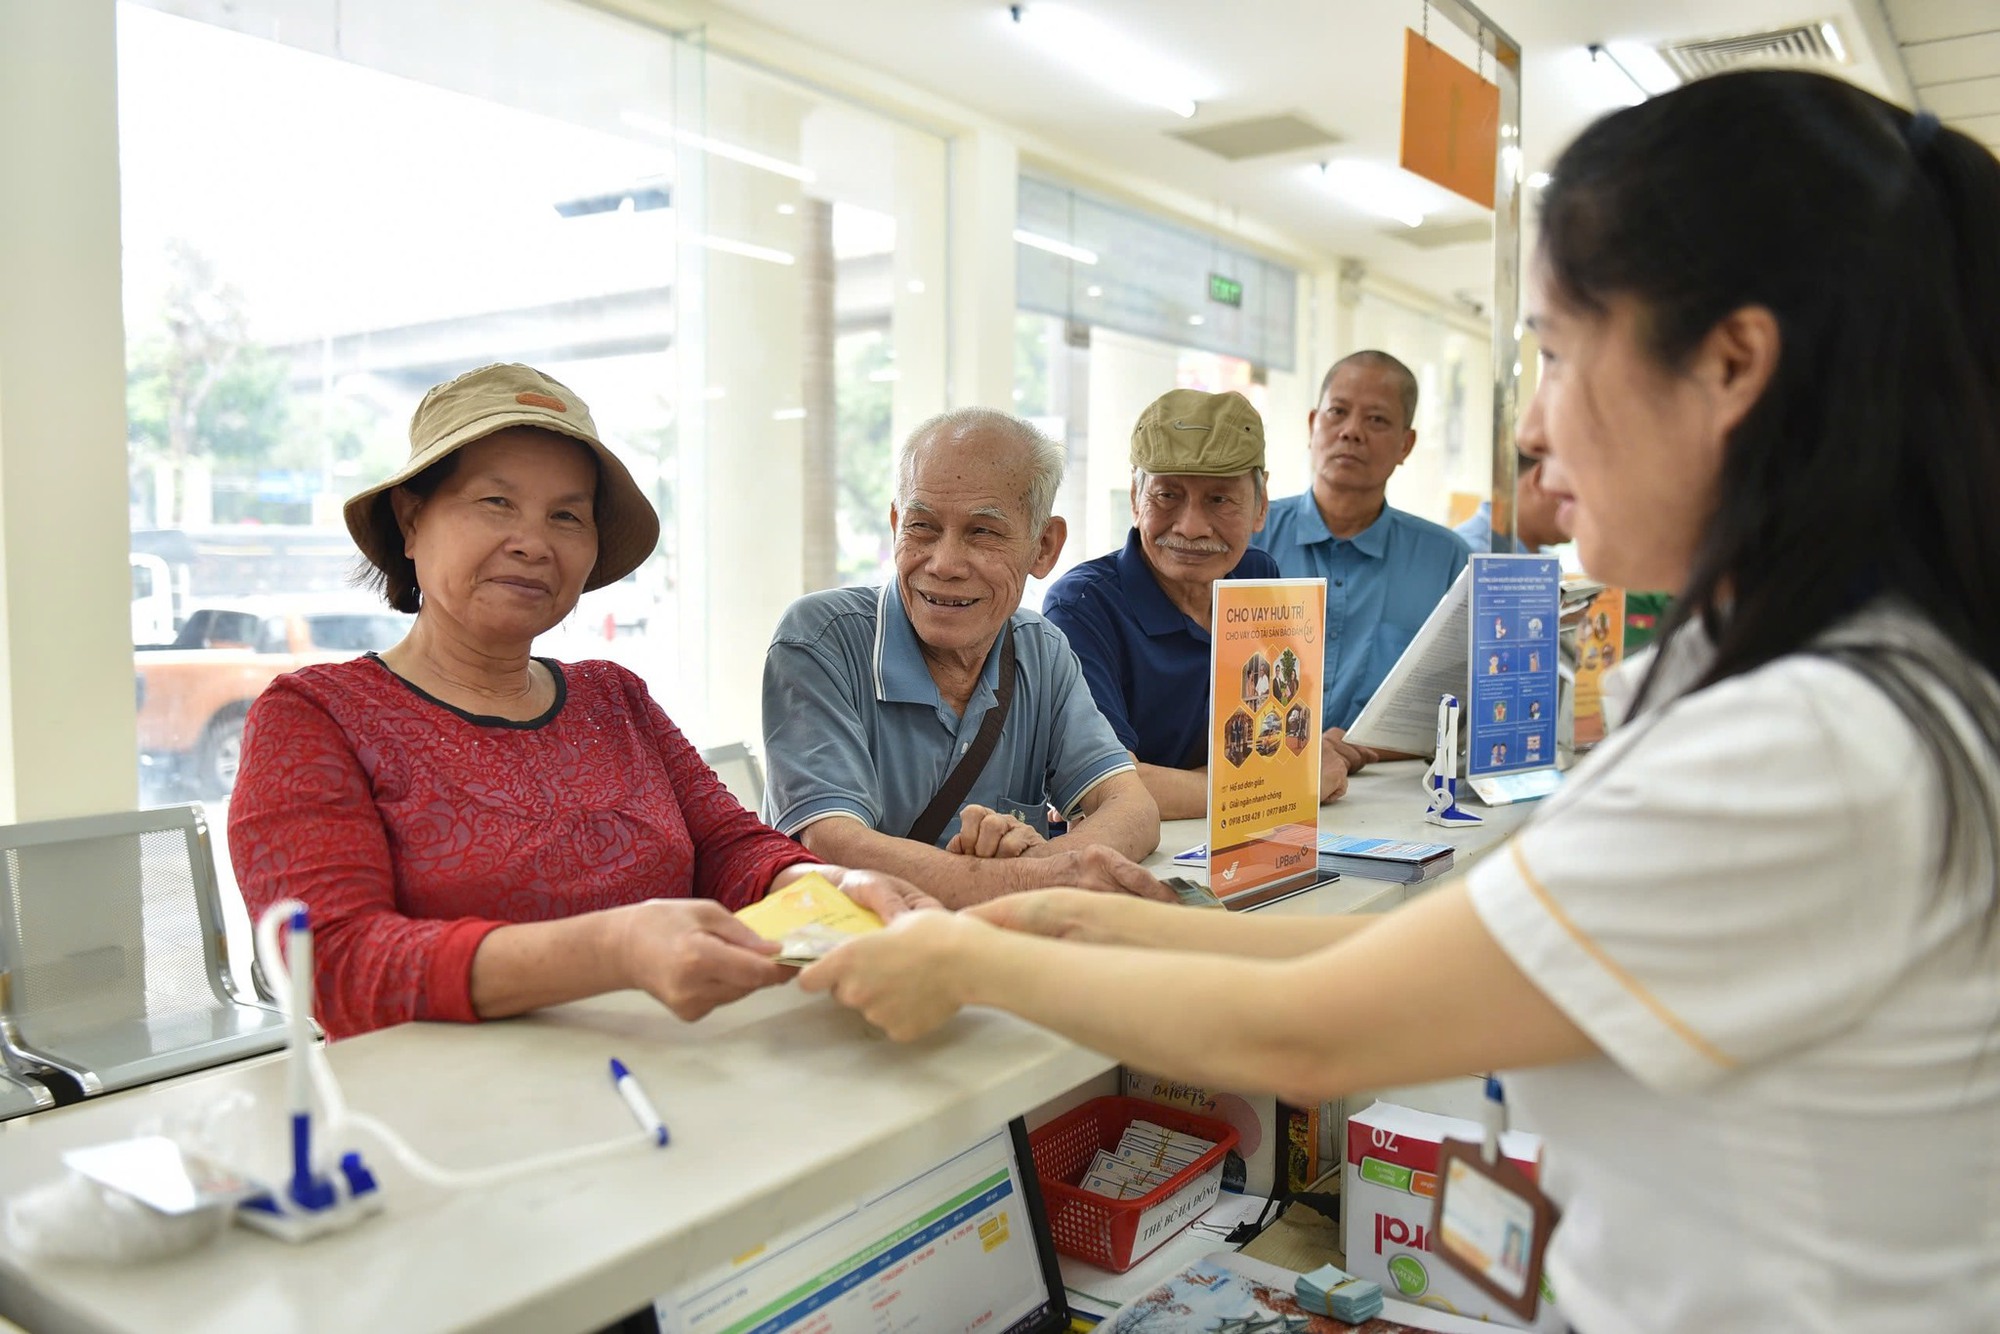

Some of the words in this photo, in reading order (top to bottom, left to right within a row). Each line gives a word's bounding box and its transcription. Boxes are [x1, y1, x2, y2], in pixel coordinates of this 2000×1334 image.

[1226, 608, 1249, 623] CHO
[1251, 607, 1269, 622] VAY
[1225, 631, 1239, 641] CHO
[1240, 630, 1250, 640] VAY
[1275, 852, 1302, 869] LPBank
[1192, 1181, 1218, 1208] ĐÔNG
